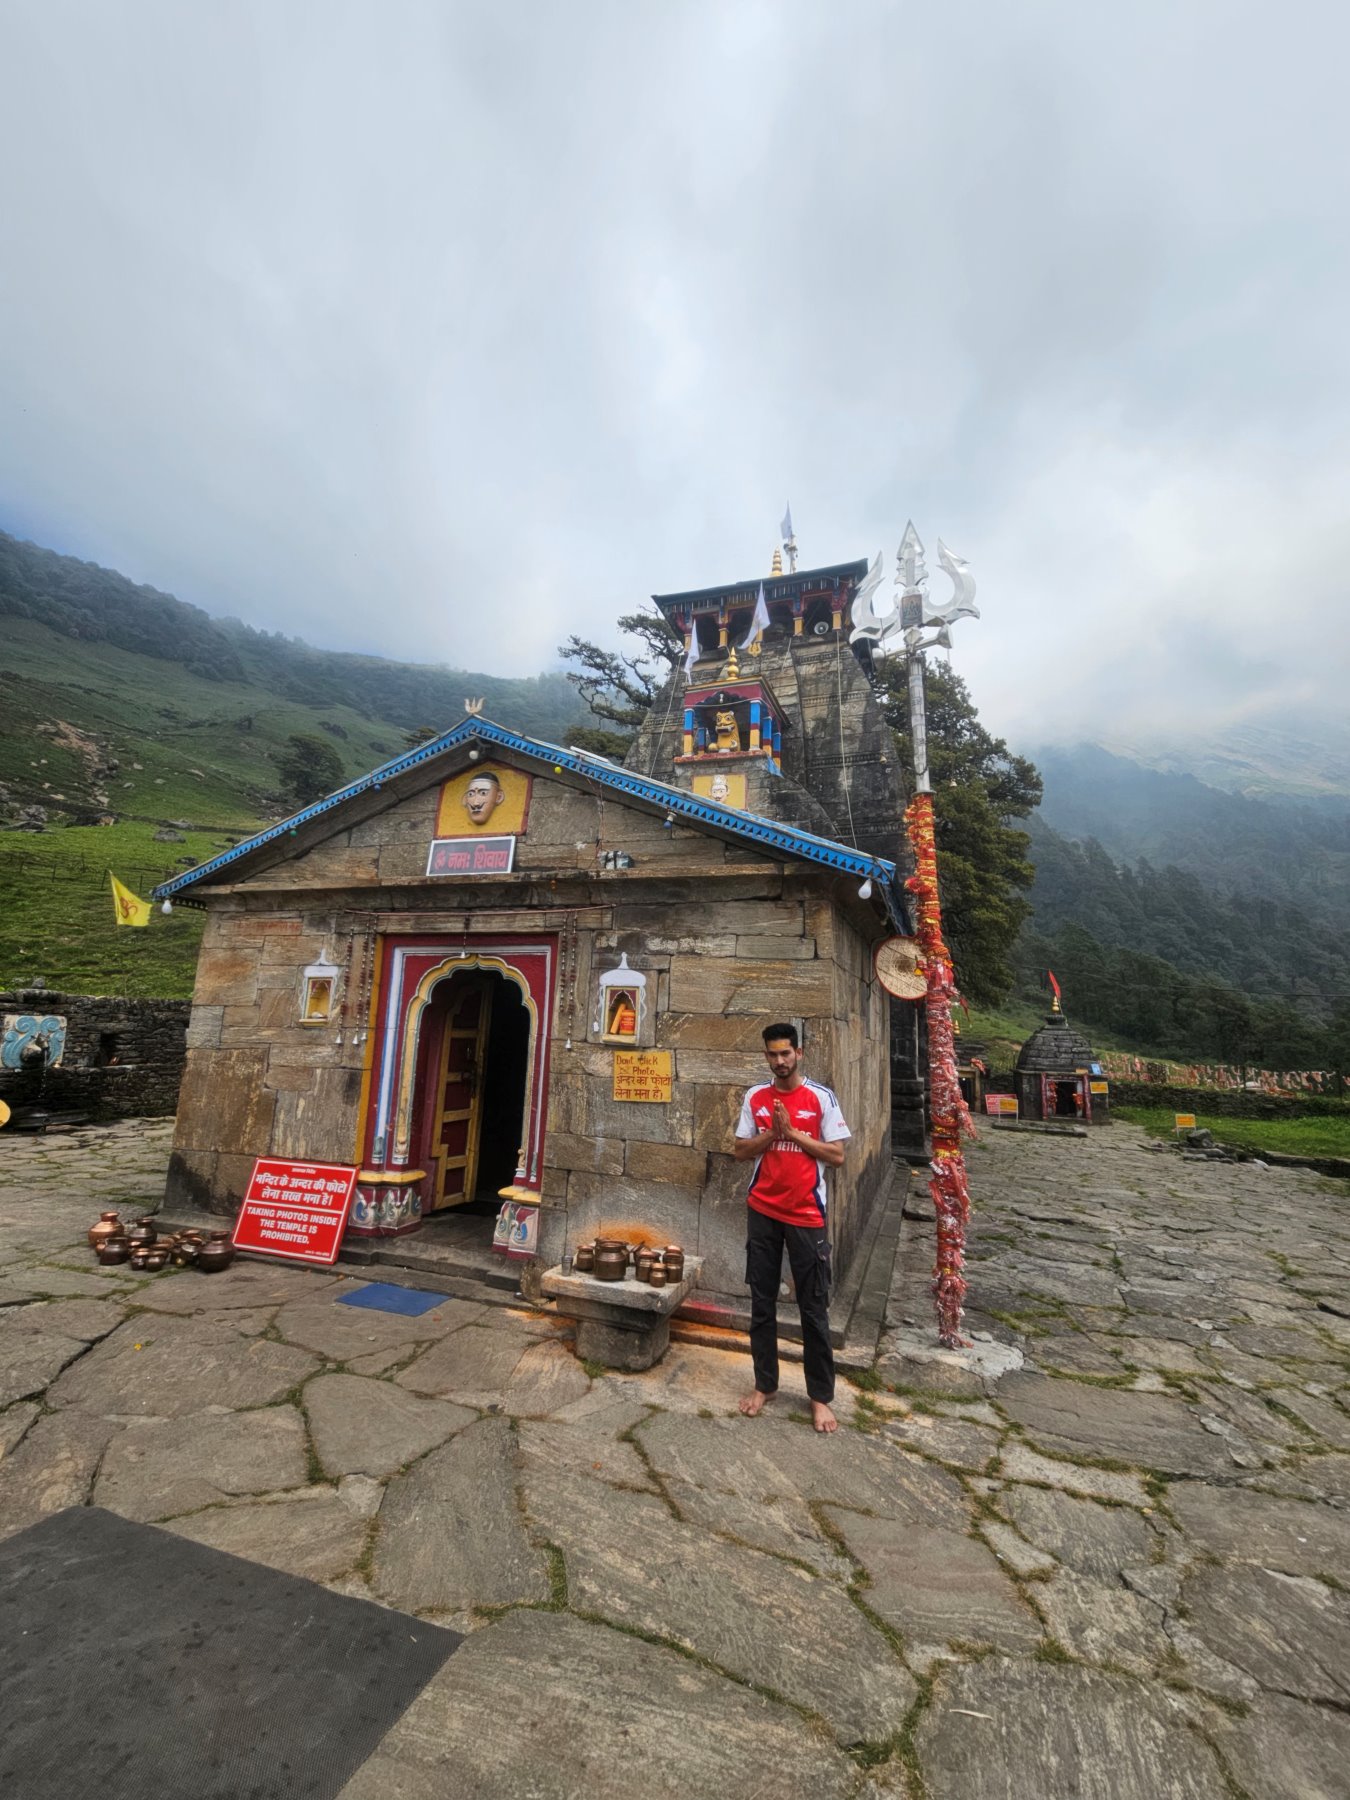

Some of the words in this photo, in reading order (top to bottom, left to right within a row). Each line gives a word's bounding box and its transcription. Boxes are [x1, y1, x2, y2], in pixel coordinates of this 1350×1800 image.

[448, 852, 470, 868] नमः
[473, 844, 508, 869] शिवाय
[615, 1085, 632, 1099] लेना
[633, 1088, 651, 1100] मना
[280, 1175, 289, 1186] के
[289, 1178, 313, 1189] अन्दर
[313, 1178, 326, 1191] की
[326, 1180, 347, 1193] फोटो
[262, 1186, 280, 1198] लेना
[303, 1194, 321, 1204] मना
[247, 1207, 275, 1217] TAKING
[276, 1211, 308, 1221] PHOTOS
[310, 1215, 338, 1226] INSIDE
[260, 1219, 275, 1228] THE
[277, 1222, 308, 1232] TEMPLE
[308, 1225, 318, 1234] IS
[260, 1230, 309, 1244] PROHIBITED.
